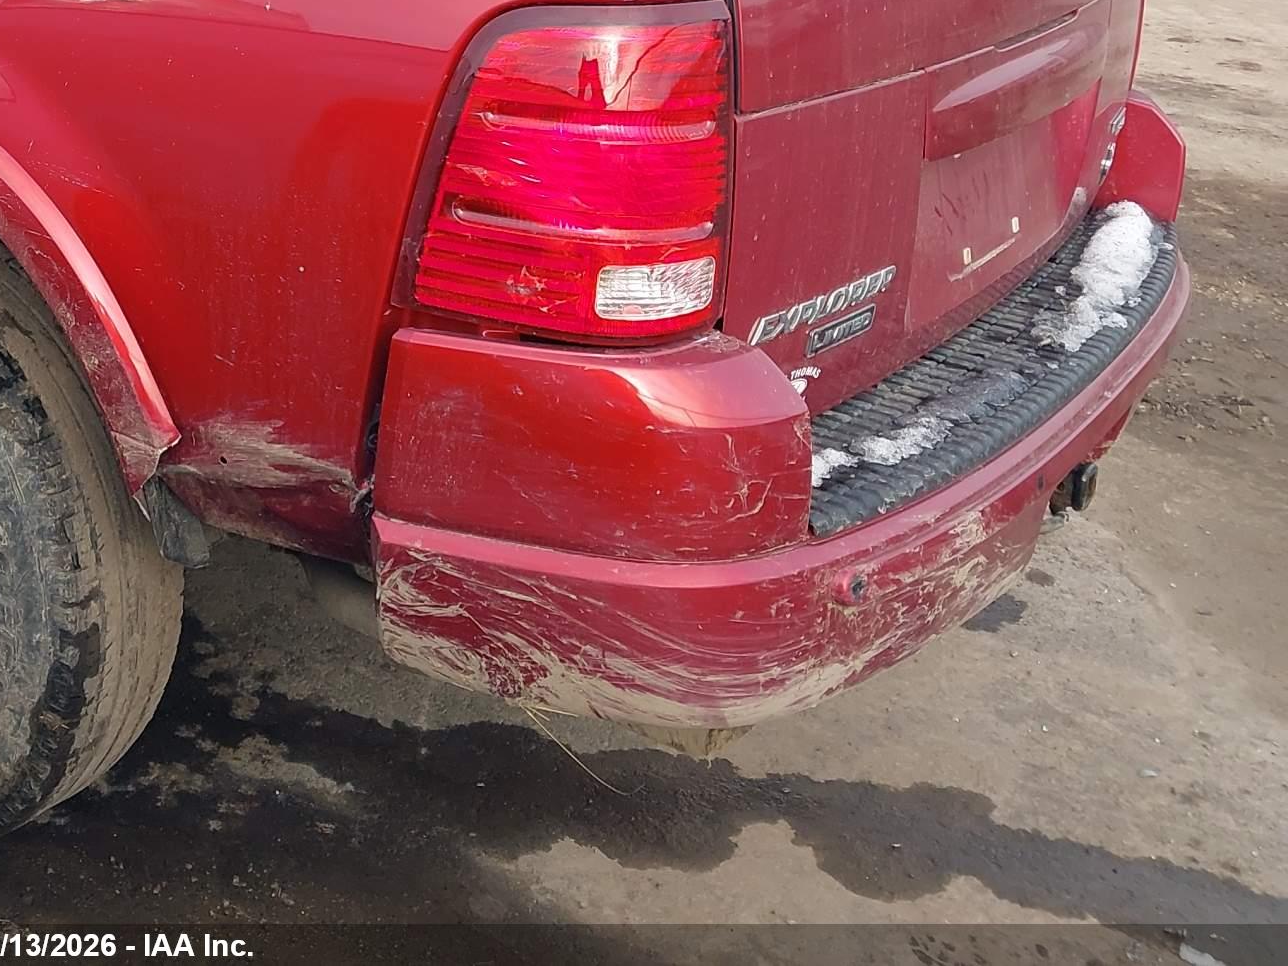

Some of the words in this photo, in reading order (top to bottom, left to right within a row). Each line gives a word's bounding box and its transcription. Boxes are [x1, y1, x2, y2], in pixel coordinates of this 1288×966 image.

[747, 265, 897, 346] EXPLORER
[813, 311, 873, 349] LIMITED
[790, 366, 821, 380] THOMAS
